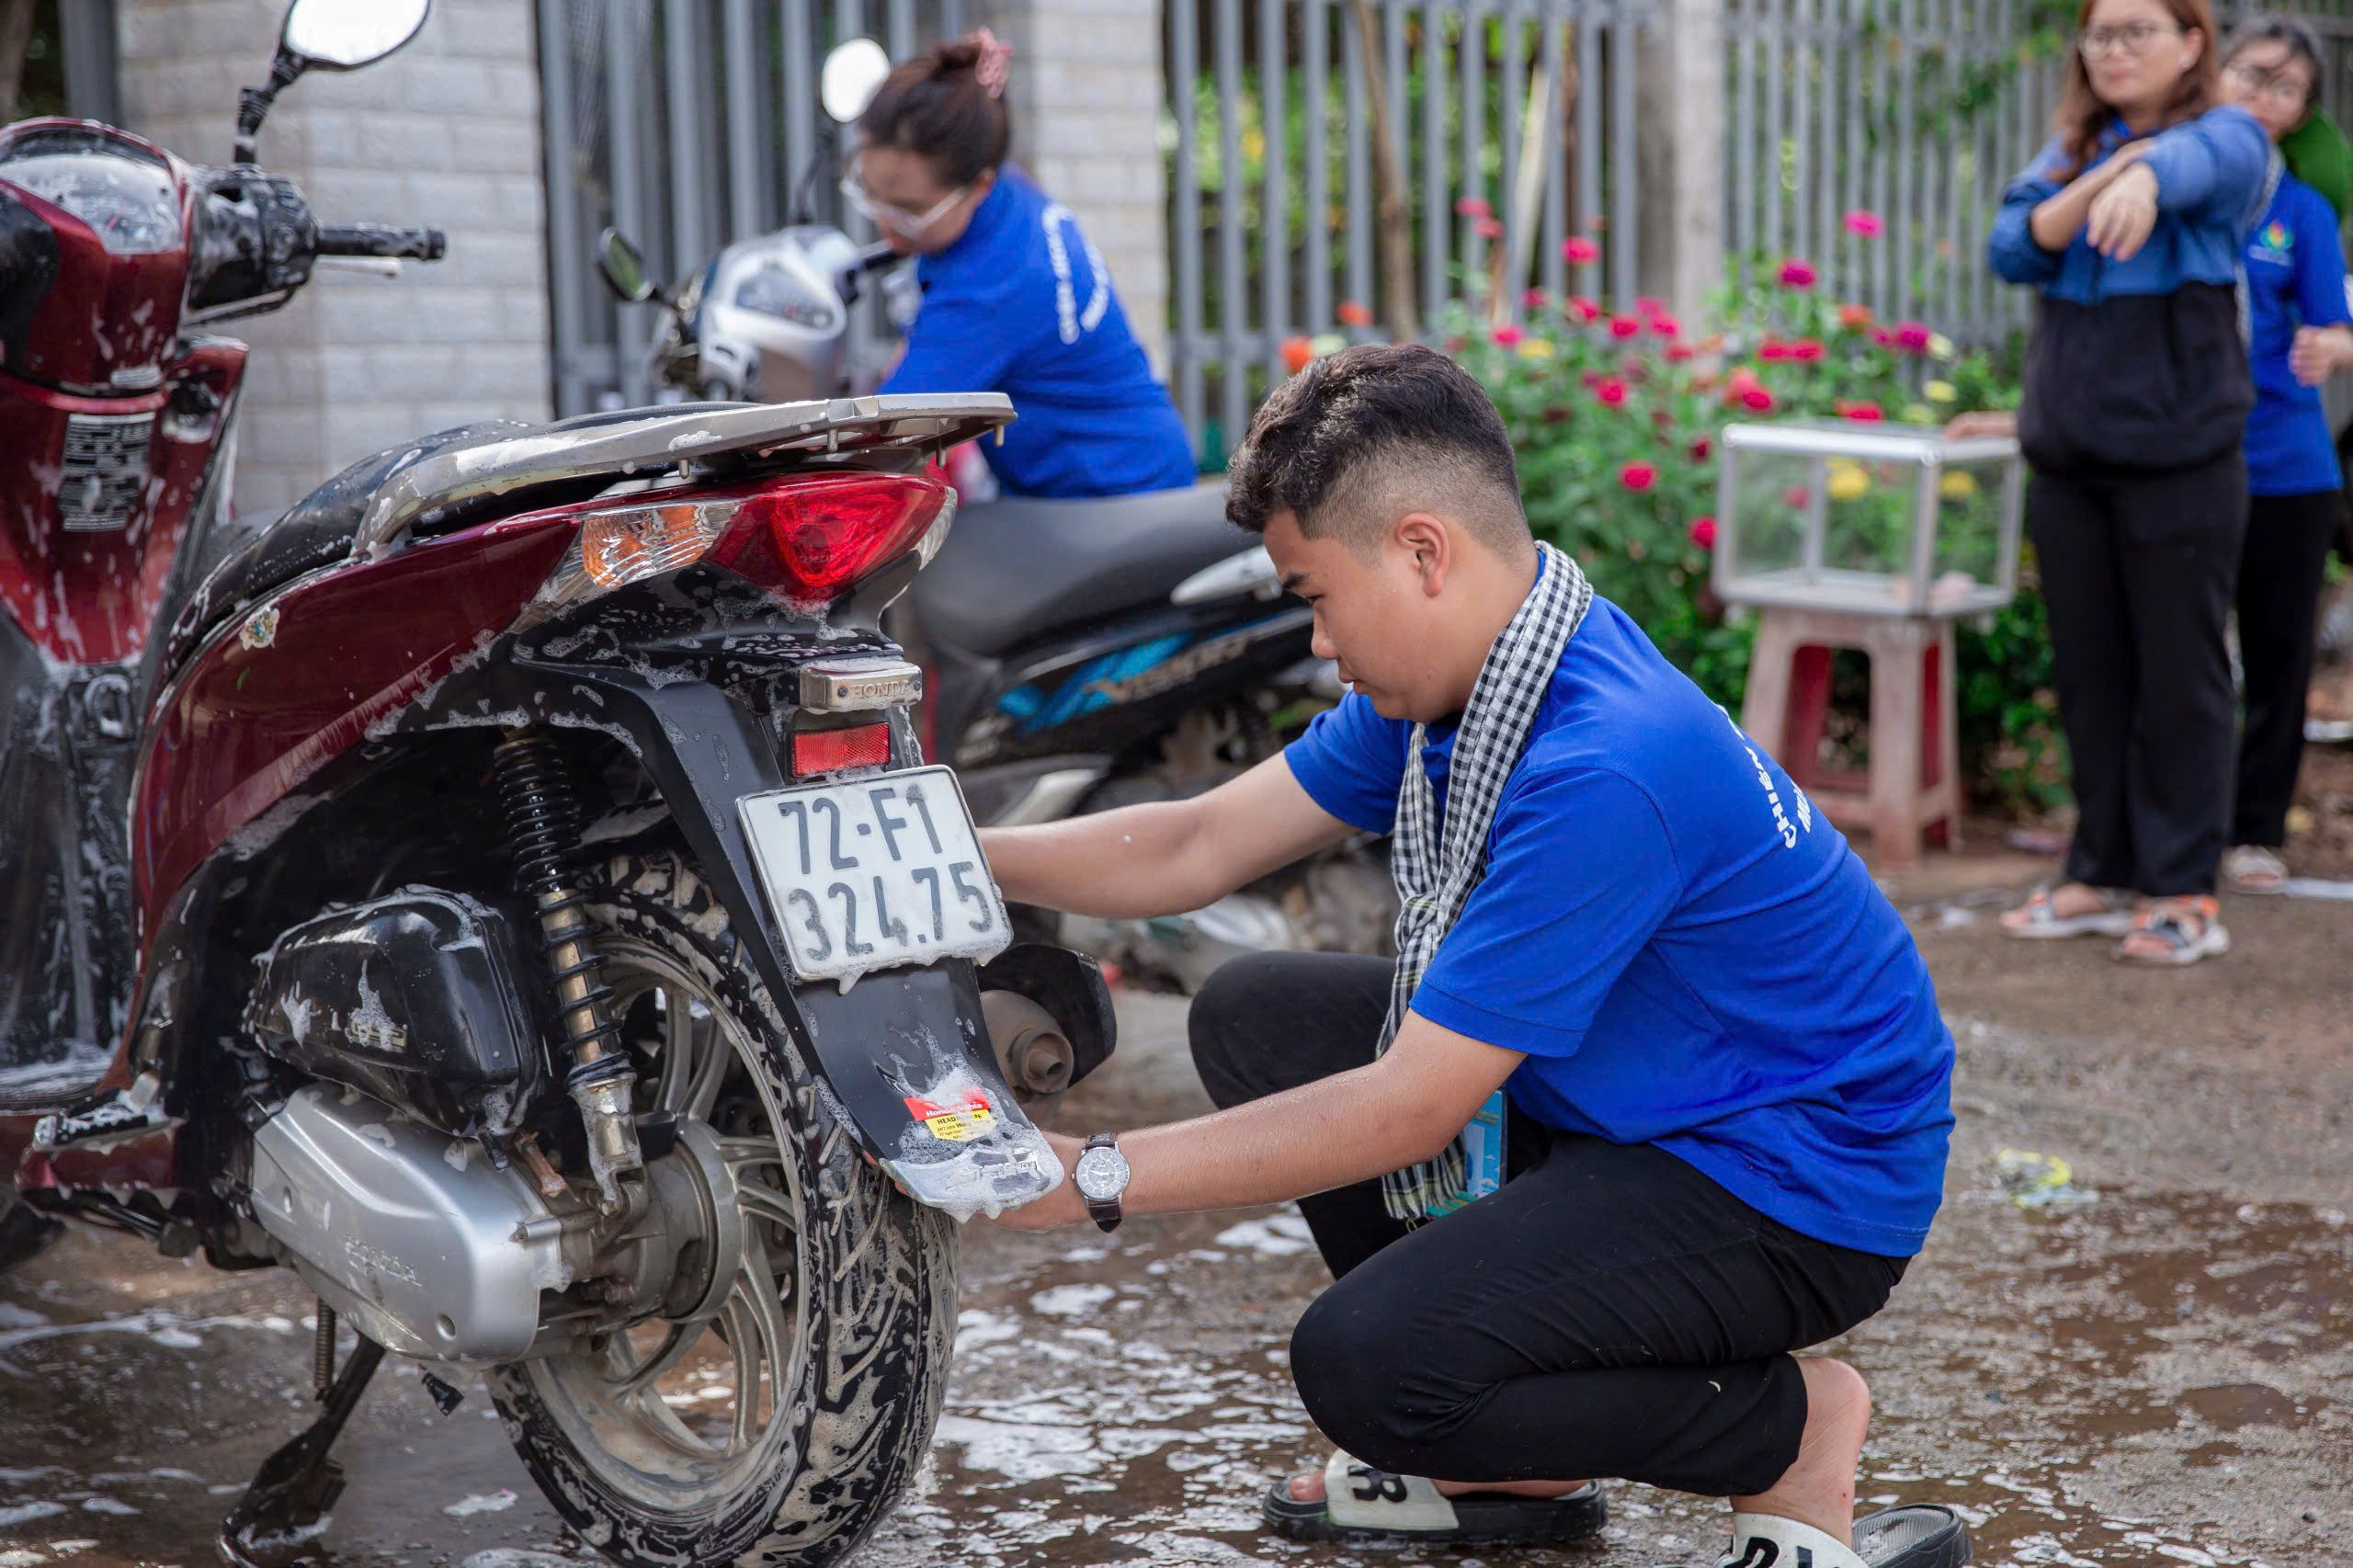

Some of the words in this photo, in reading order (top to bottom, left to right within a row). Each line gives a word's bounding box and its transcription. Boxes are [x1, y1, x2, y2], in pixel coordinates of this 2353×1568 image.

[853, 680, 909, 698] HONDA
[787, 860, 993, 961] 324.75
[937, 1116, 956, 1124] HEAD
